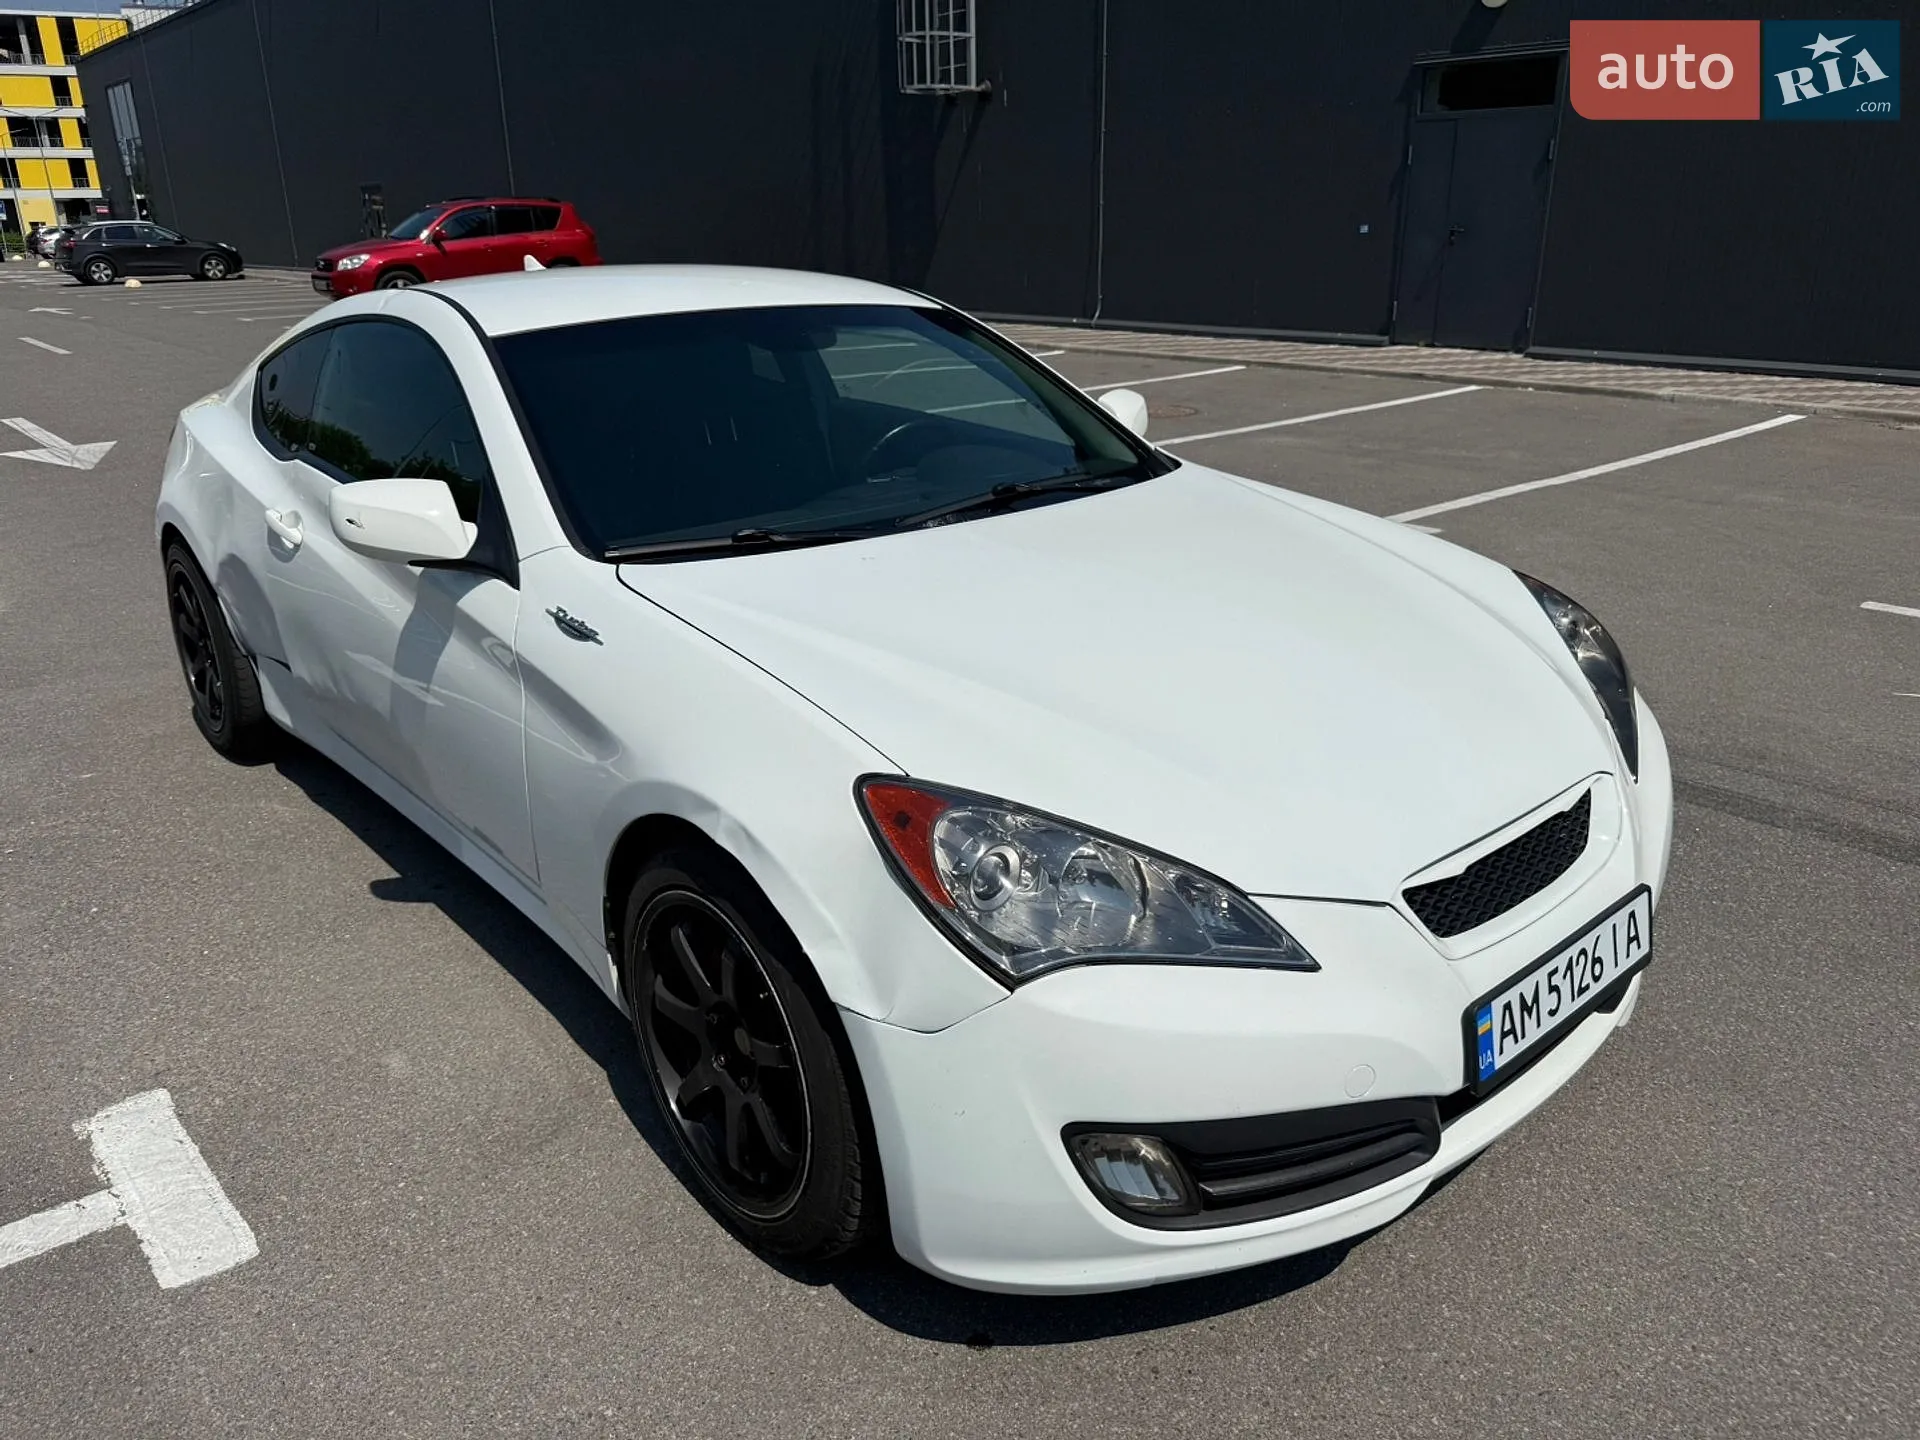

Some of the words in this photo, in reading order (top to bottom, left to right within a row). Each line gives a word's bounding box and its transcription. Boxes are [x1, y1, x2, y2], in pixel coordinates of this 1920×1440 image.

[1498, 980, 1542, 1056] AM
[1547, 934, 1604, 1017] 5126
[1478, 1049, 1493, 1070] UA
